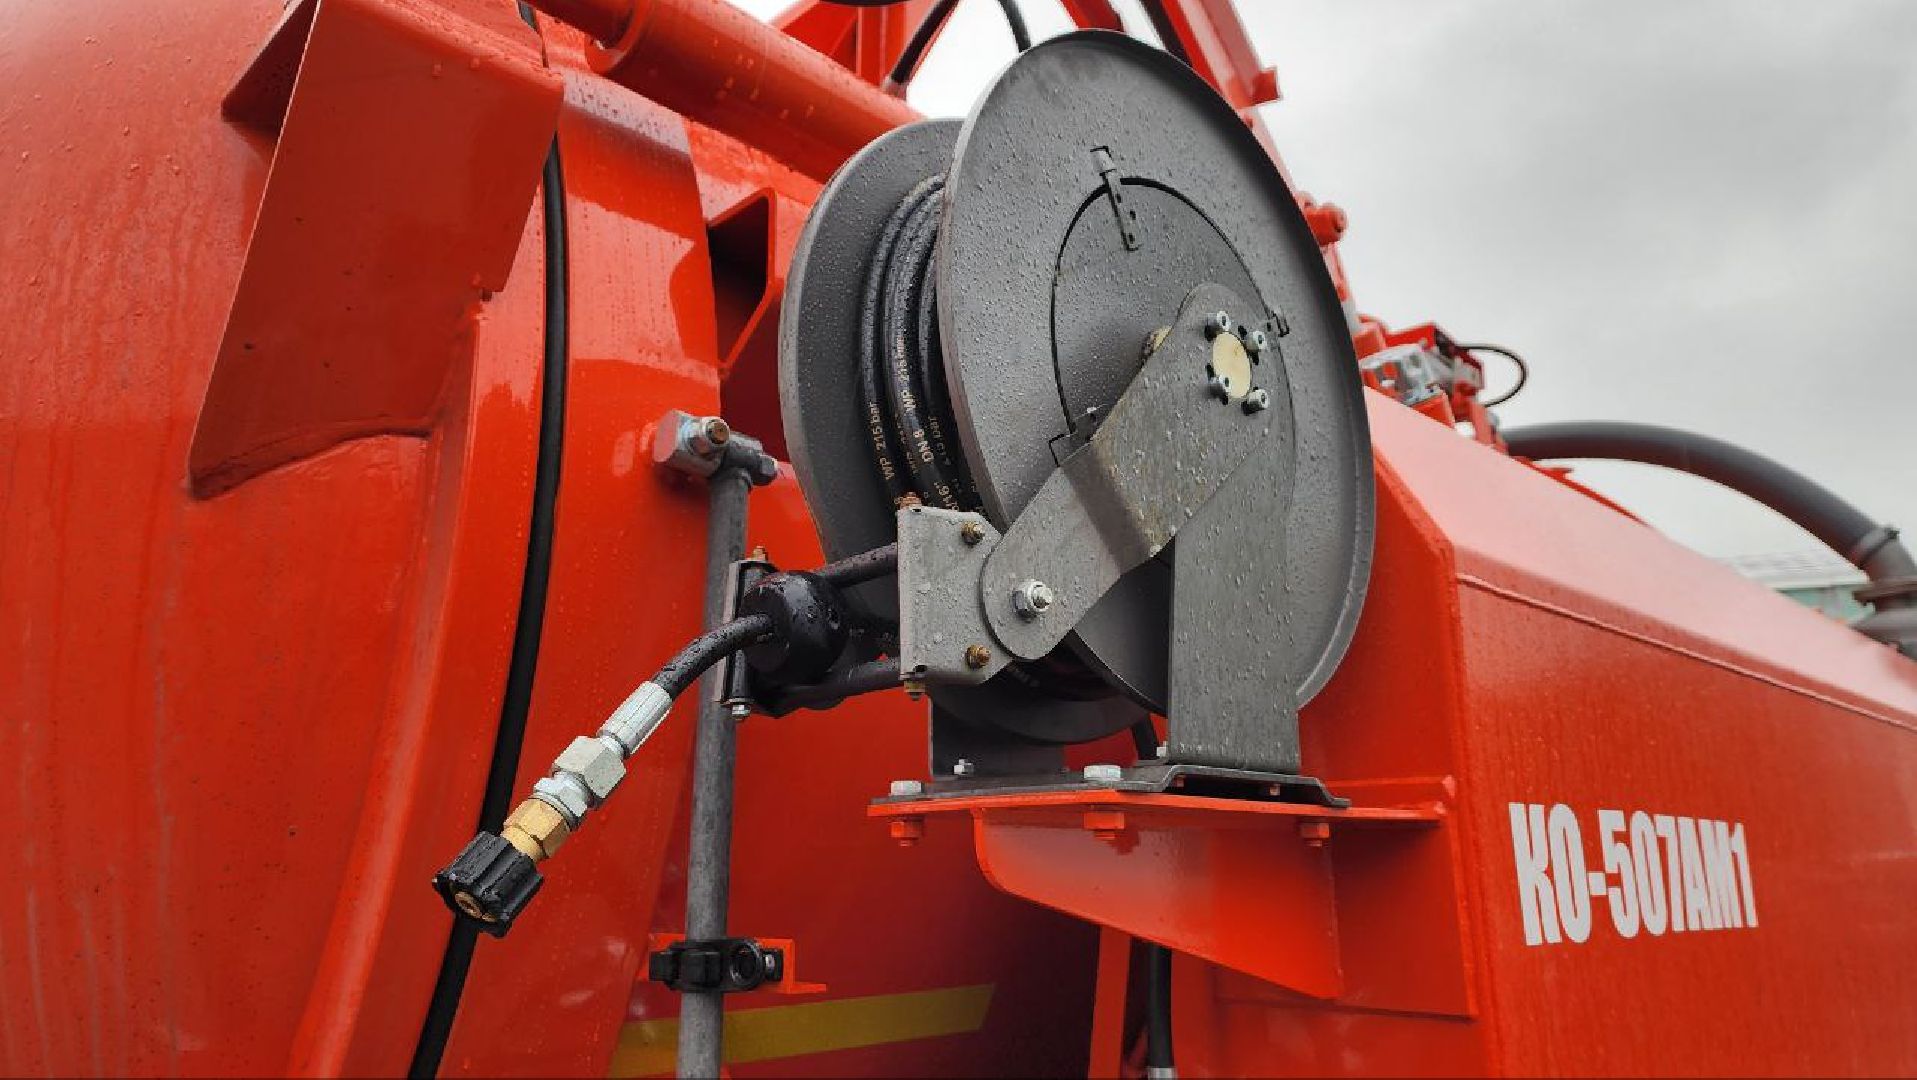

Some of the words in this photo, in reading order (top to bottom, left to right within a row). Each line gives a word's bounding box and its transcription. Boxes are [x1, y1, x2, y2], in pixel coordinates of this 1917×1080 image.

[868, 401, 881, 425] bar
[901, 389, 916, 416] WP
[873, 426, 887, 451] 215
[912, 428, 925, 439] 8
[918, 440, 935, 462] DN
[880, 457, 896, 480] WP
